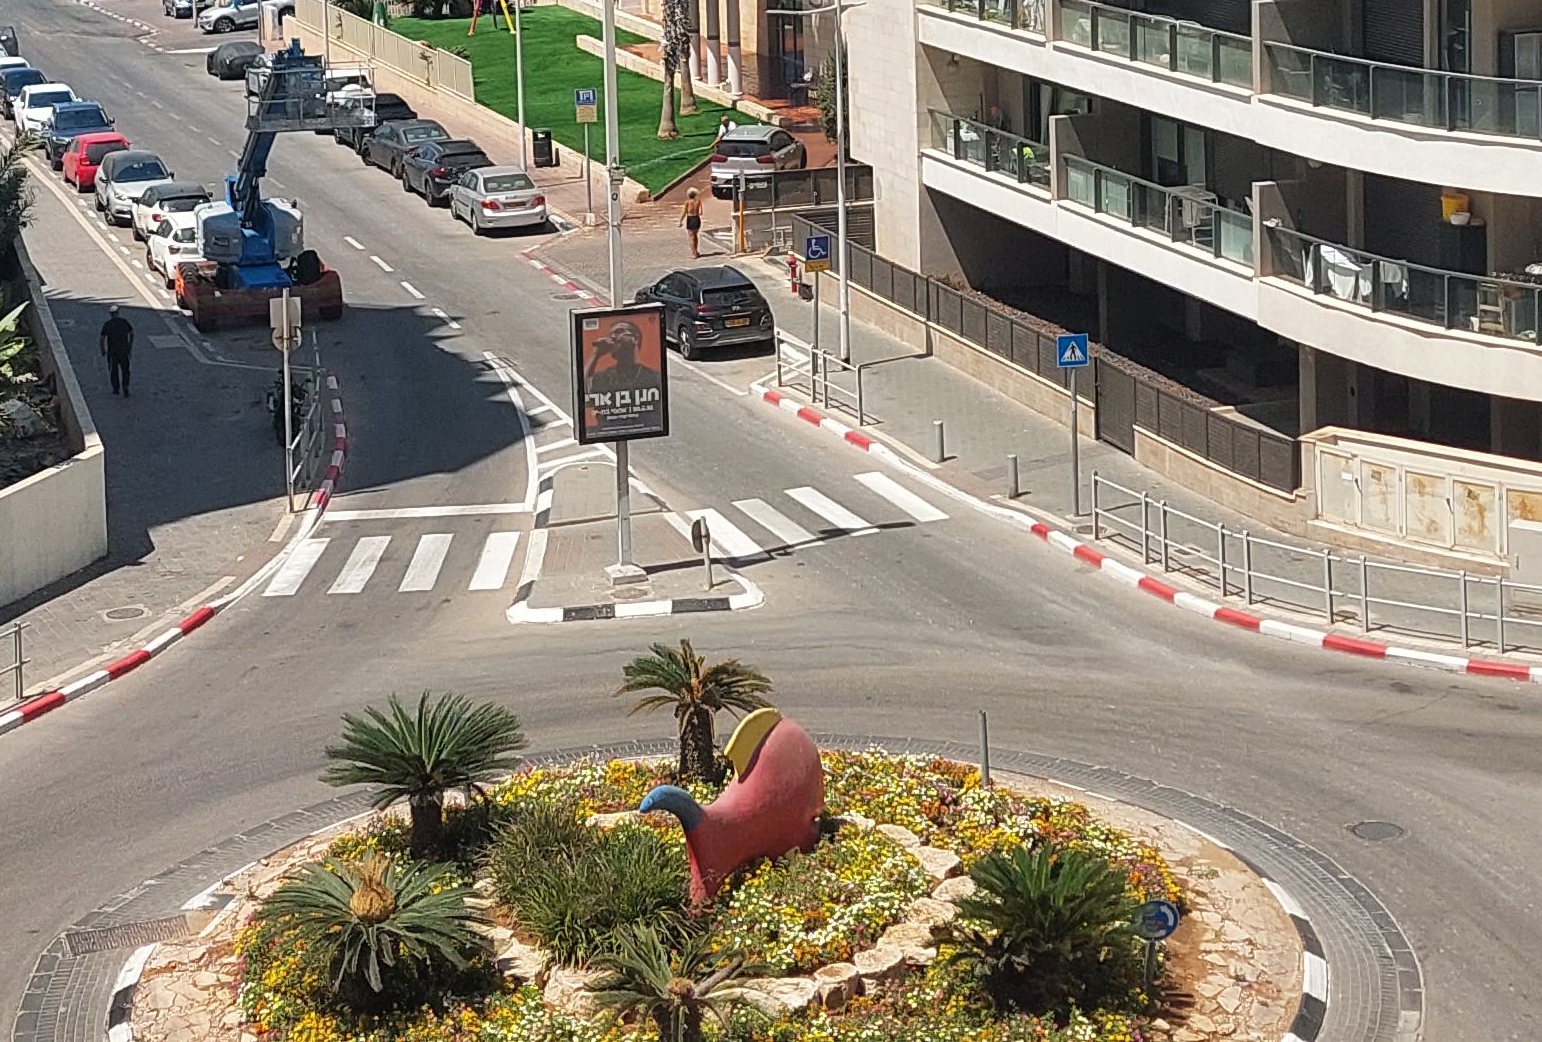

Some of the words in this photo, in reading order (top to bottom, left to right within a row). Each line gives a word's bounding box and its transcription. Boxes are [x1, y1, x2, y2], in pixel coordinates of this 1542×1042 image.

[585, 392, 612, 407] ארי
[615, 390, 631, 408] בן
[634, 388, 660, 406] חנן
